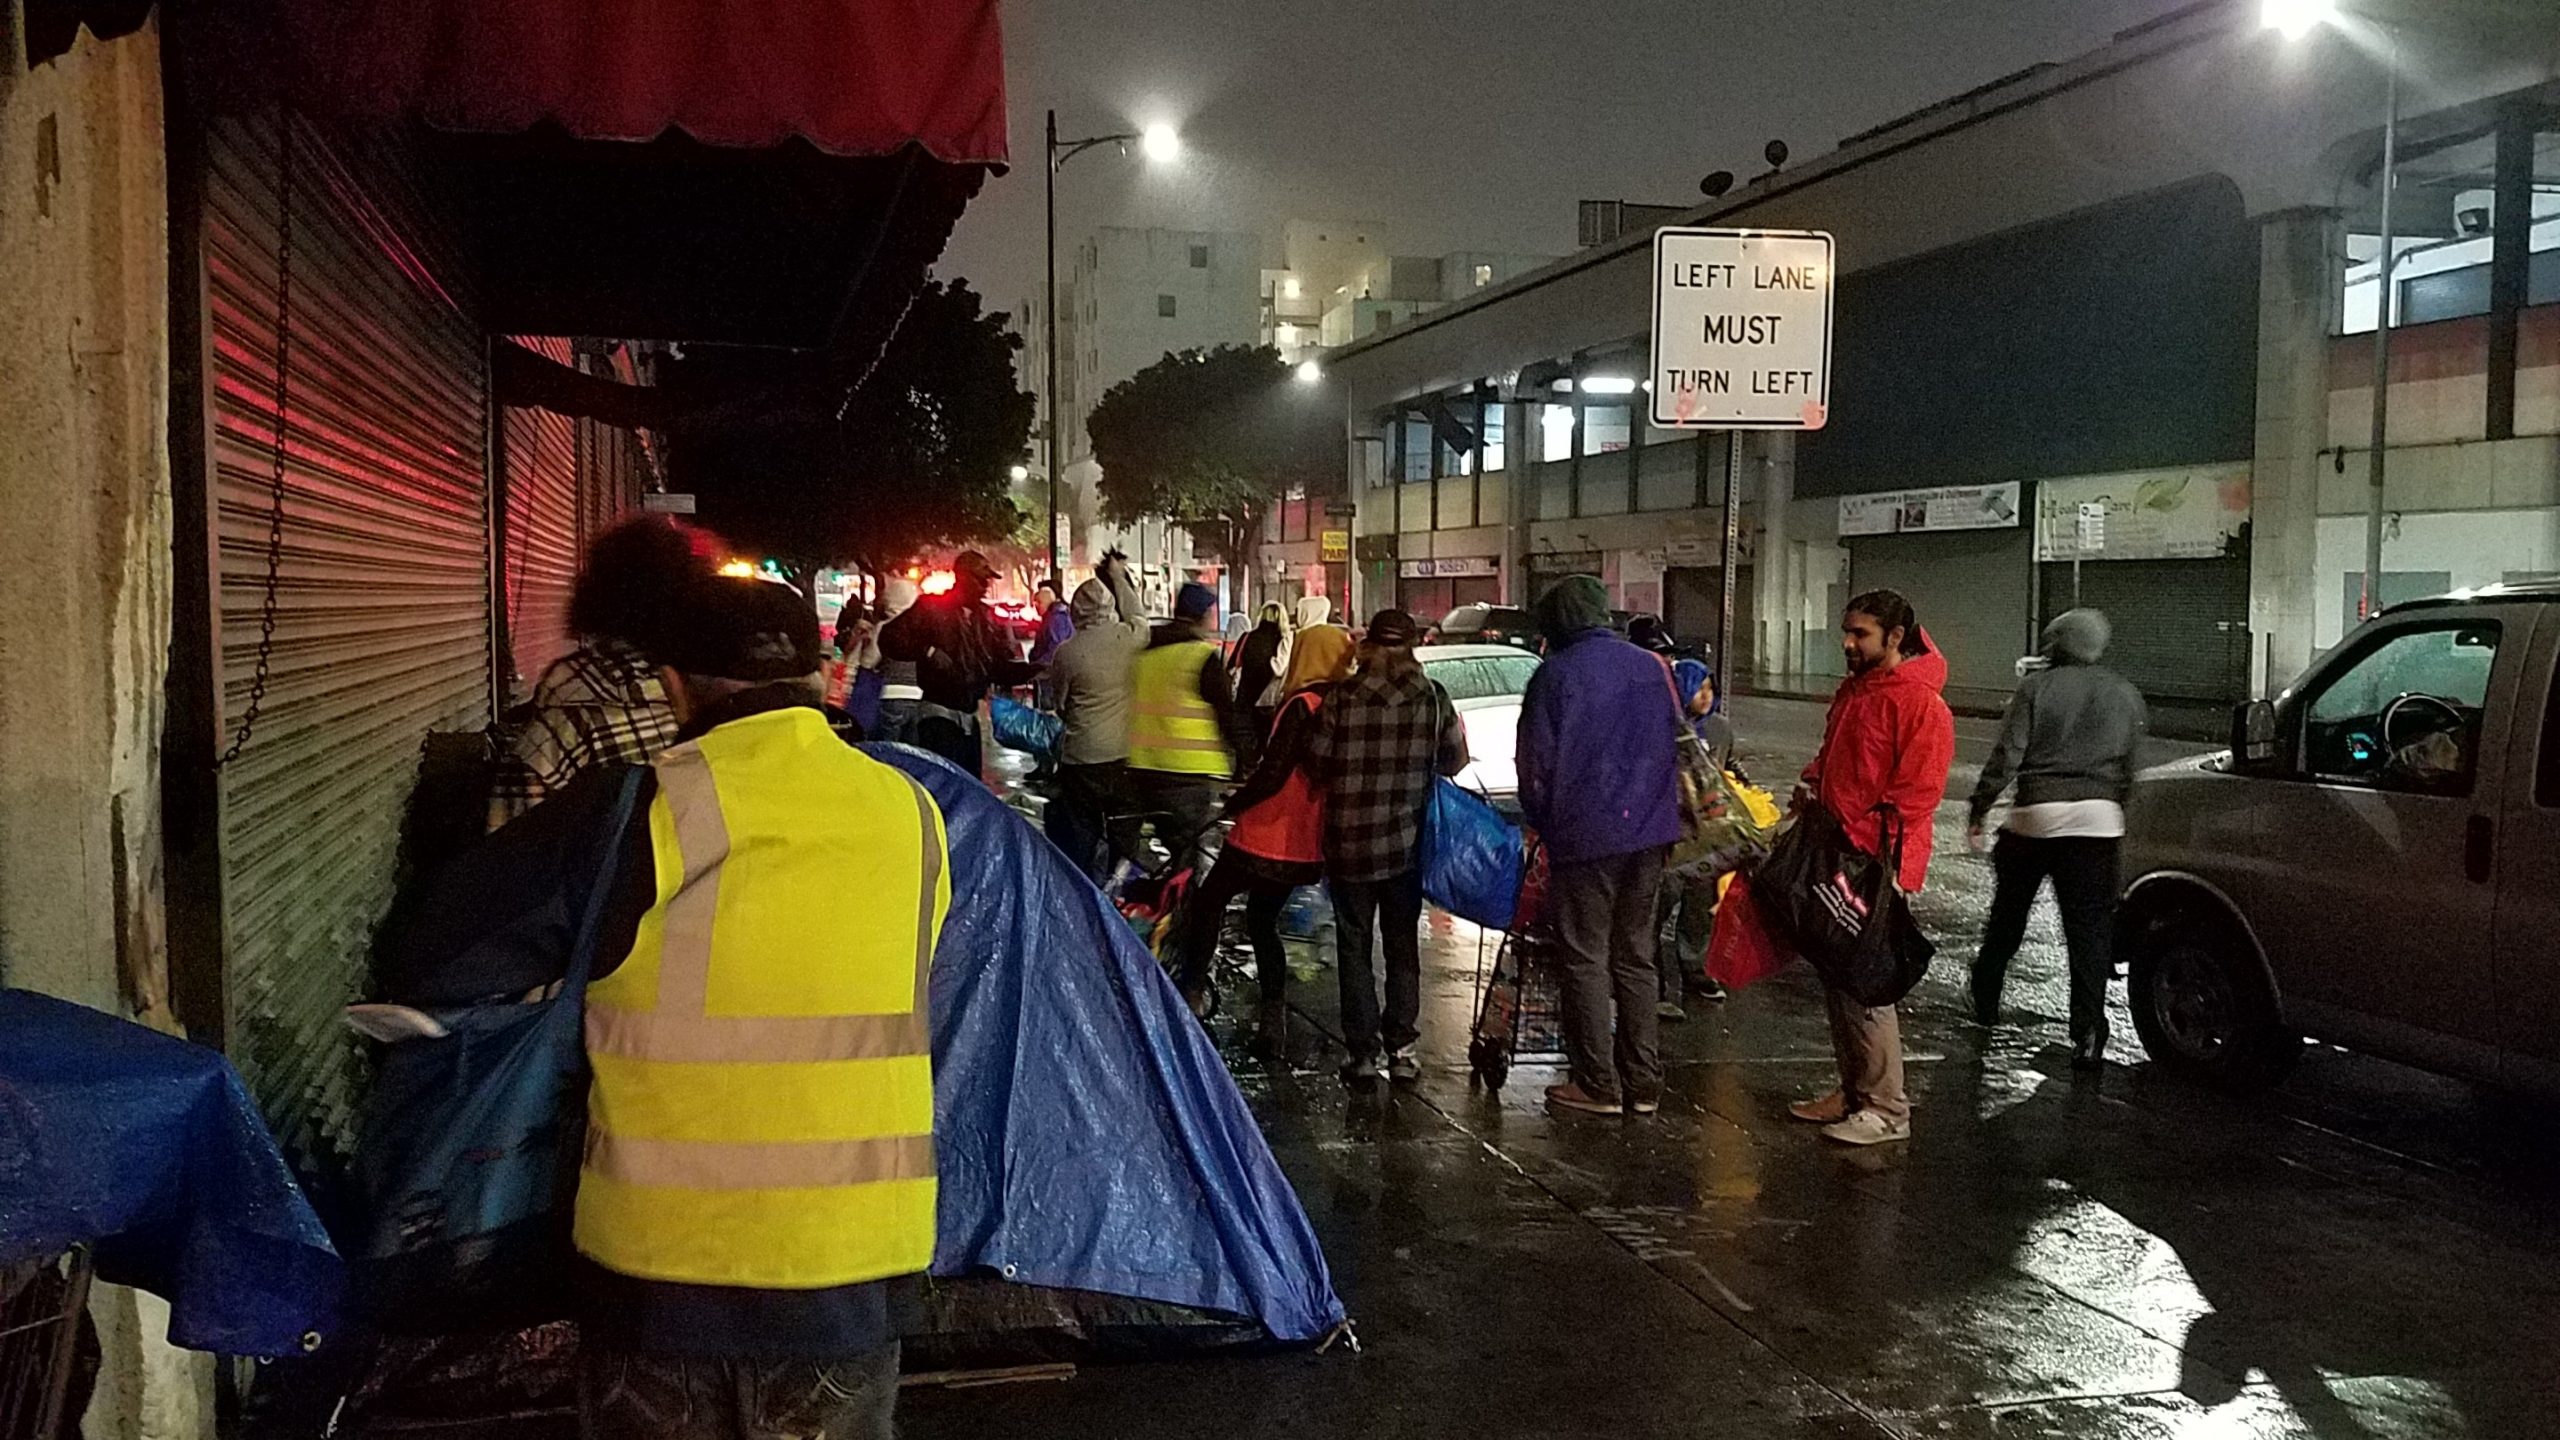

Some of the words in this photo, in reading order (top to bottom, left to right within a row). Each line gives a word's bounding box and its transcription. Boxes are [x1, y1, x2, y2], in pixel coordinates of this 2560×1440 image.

[1673, 263, 1736, 288] LEFT
[1754, 266, 1816, 290] LANE
[1703, 314, 1782, 345] MUST
[1667, 369, 1730, 394] TURN
[1752, 370, 1813, 394] LEFT
